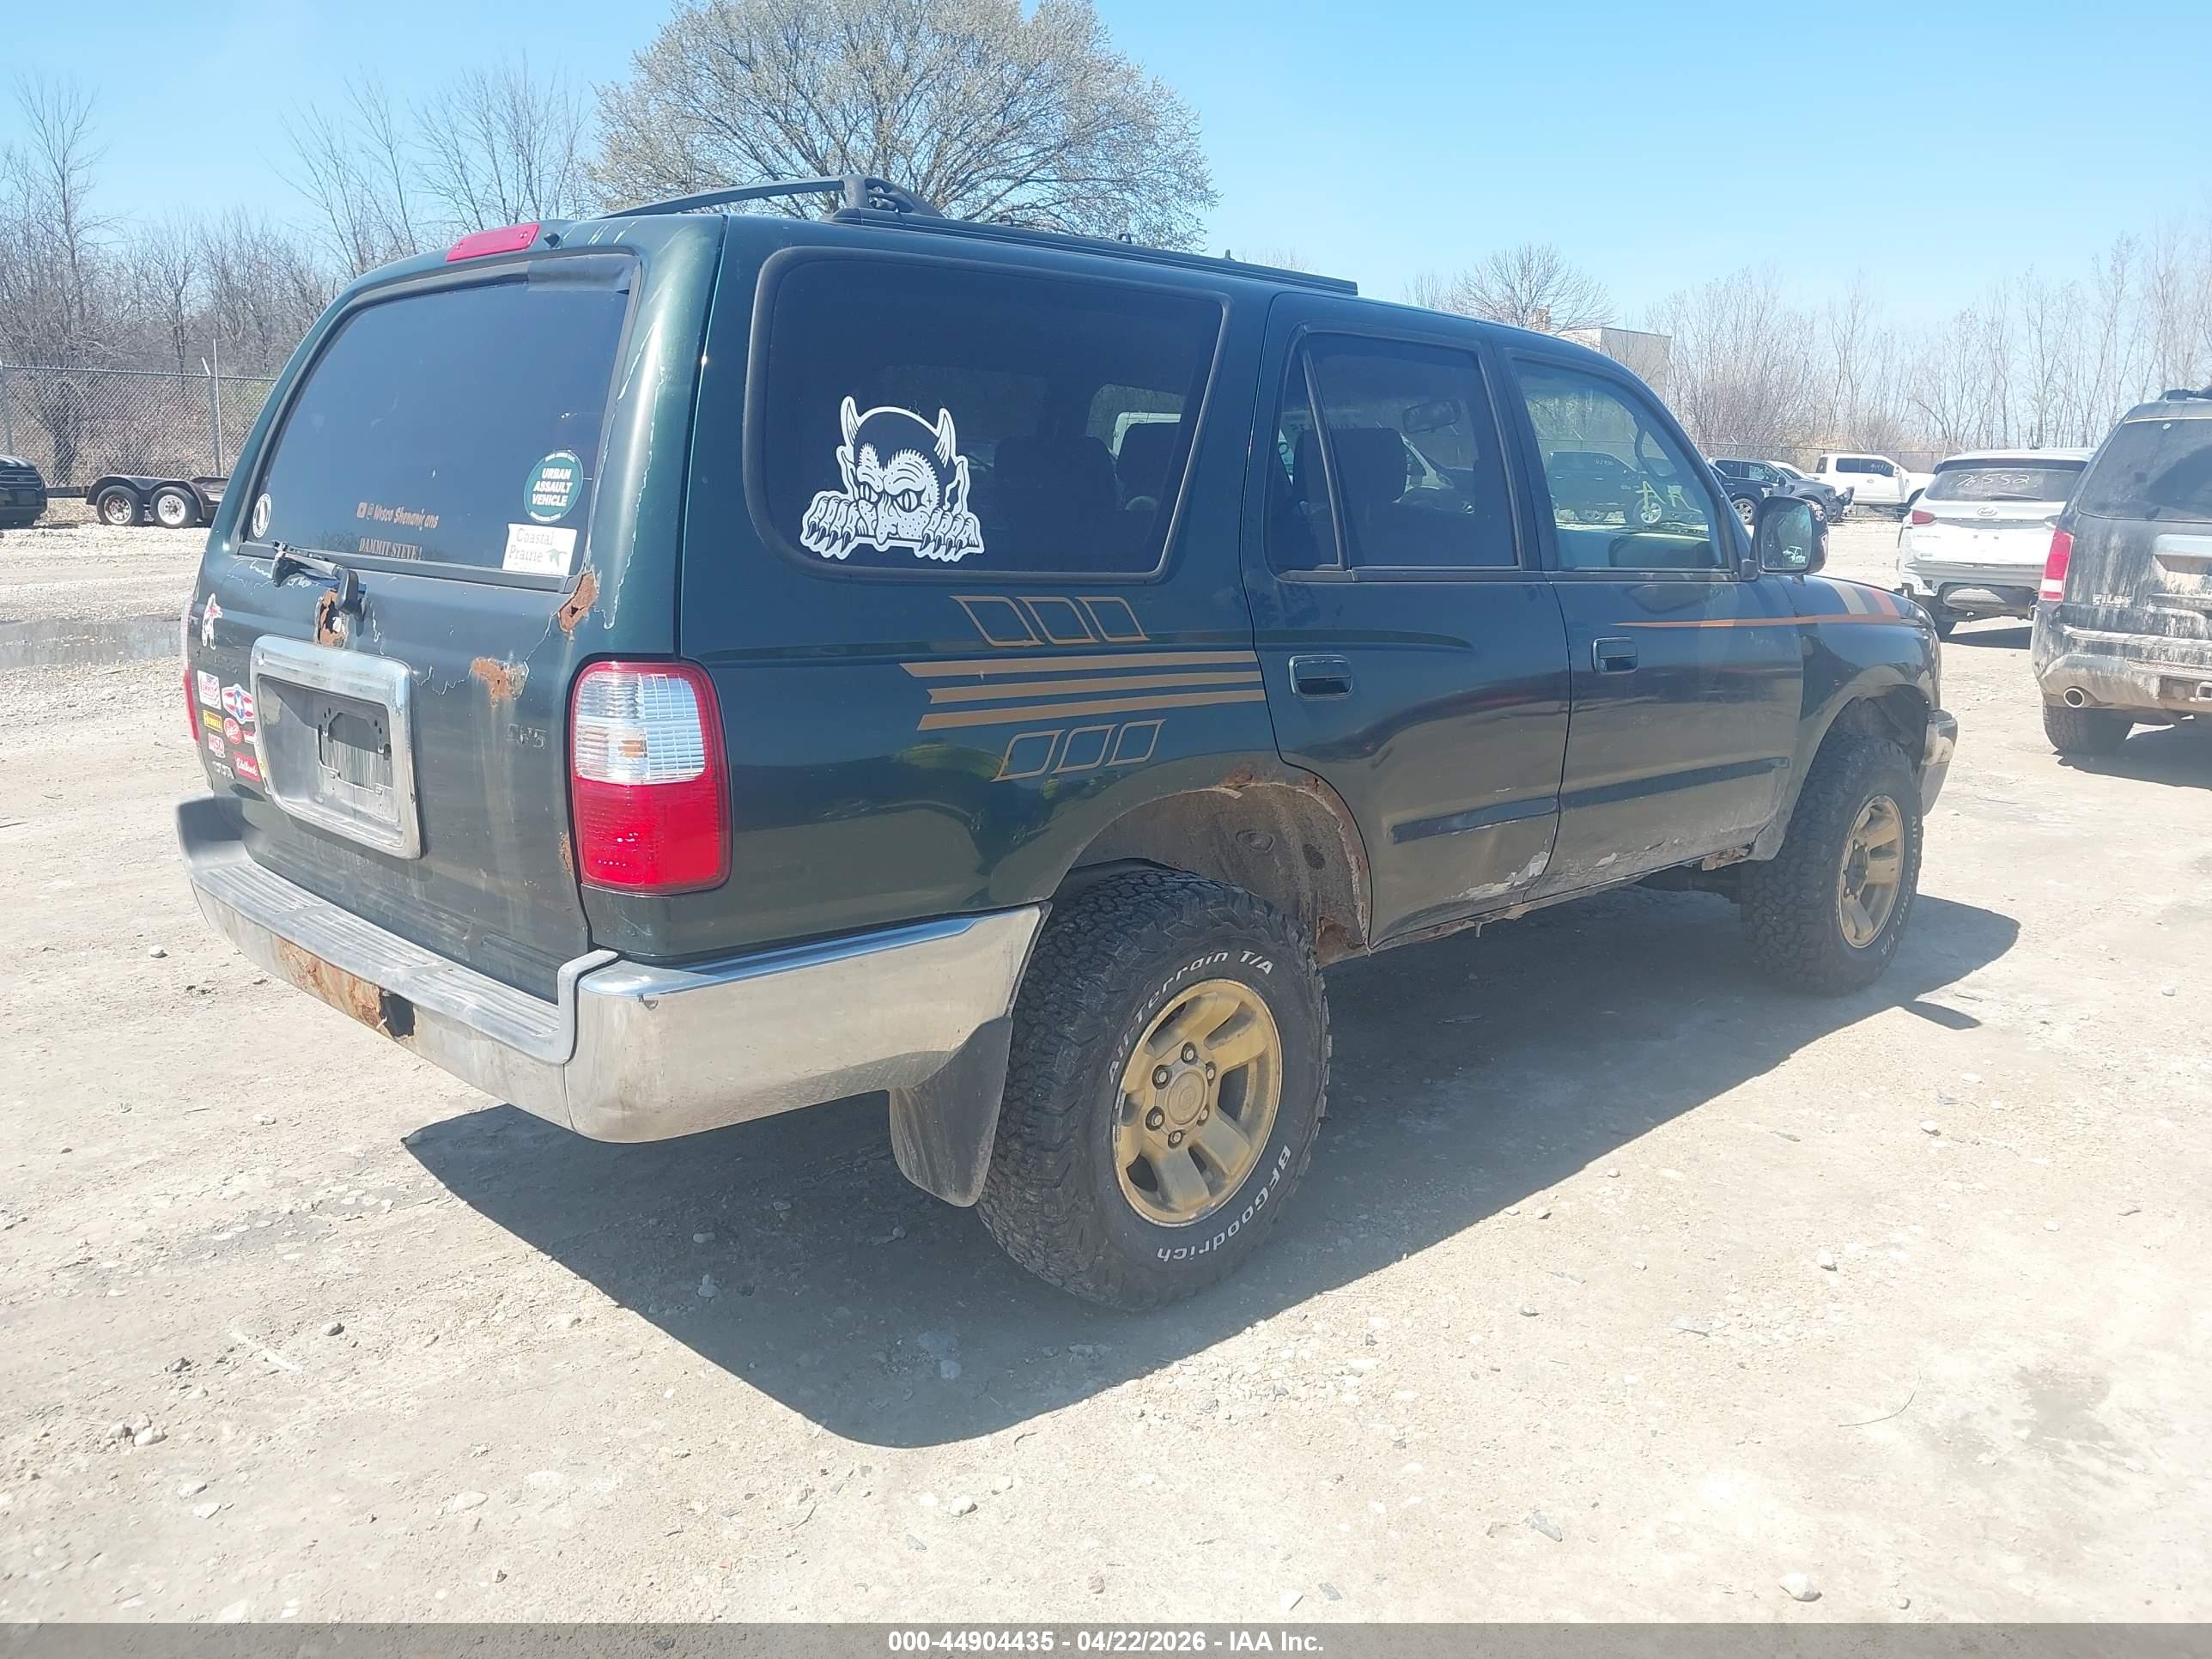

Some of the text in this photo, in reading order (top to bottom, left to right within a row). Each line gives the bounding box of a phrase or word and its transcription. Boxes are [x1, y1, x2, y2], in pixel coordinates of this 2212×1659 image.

[541, 467, 572, 480] URBAN
[532, 480, 574, 494] ASSAULT
[532, 493, 568, 507] VEHICLE
[517, 527, 555, 546] Coastal
[508, 544, 544, 562] Prairie
[1109, 950, 1275, 1085] All-Terrain T/A
[1157, 1144, 1291, 1262] BFGoodrich
